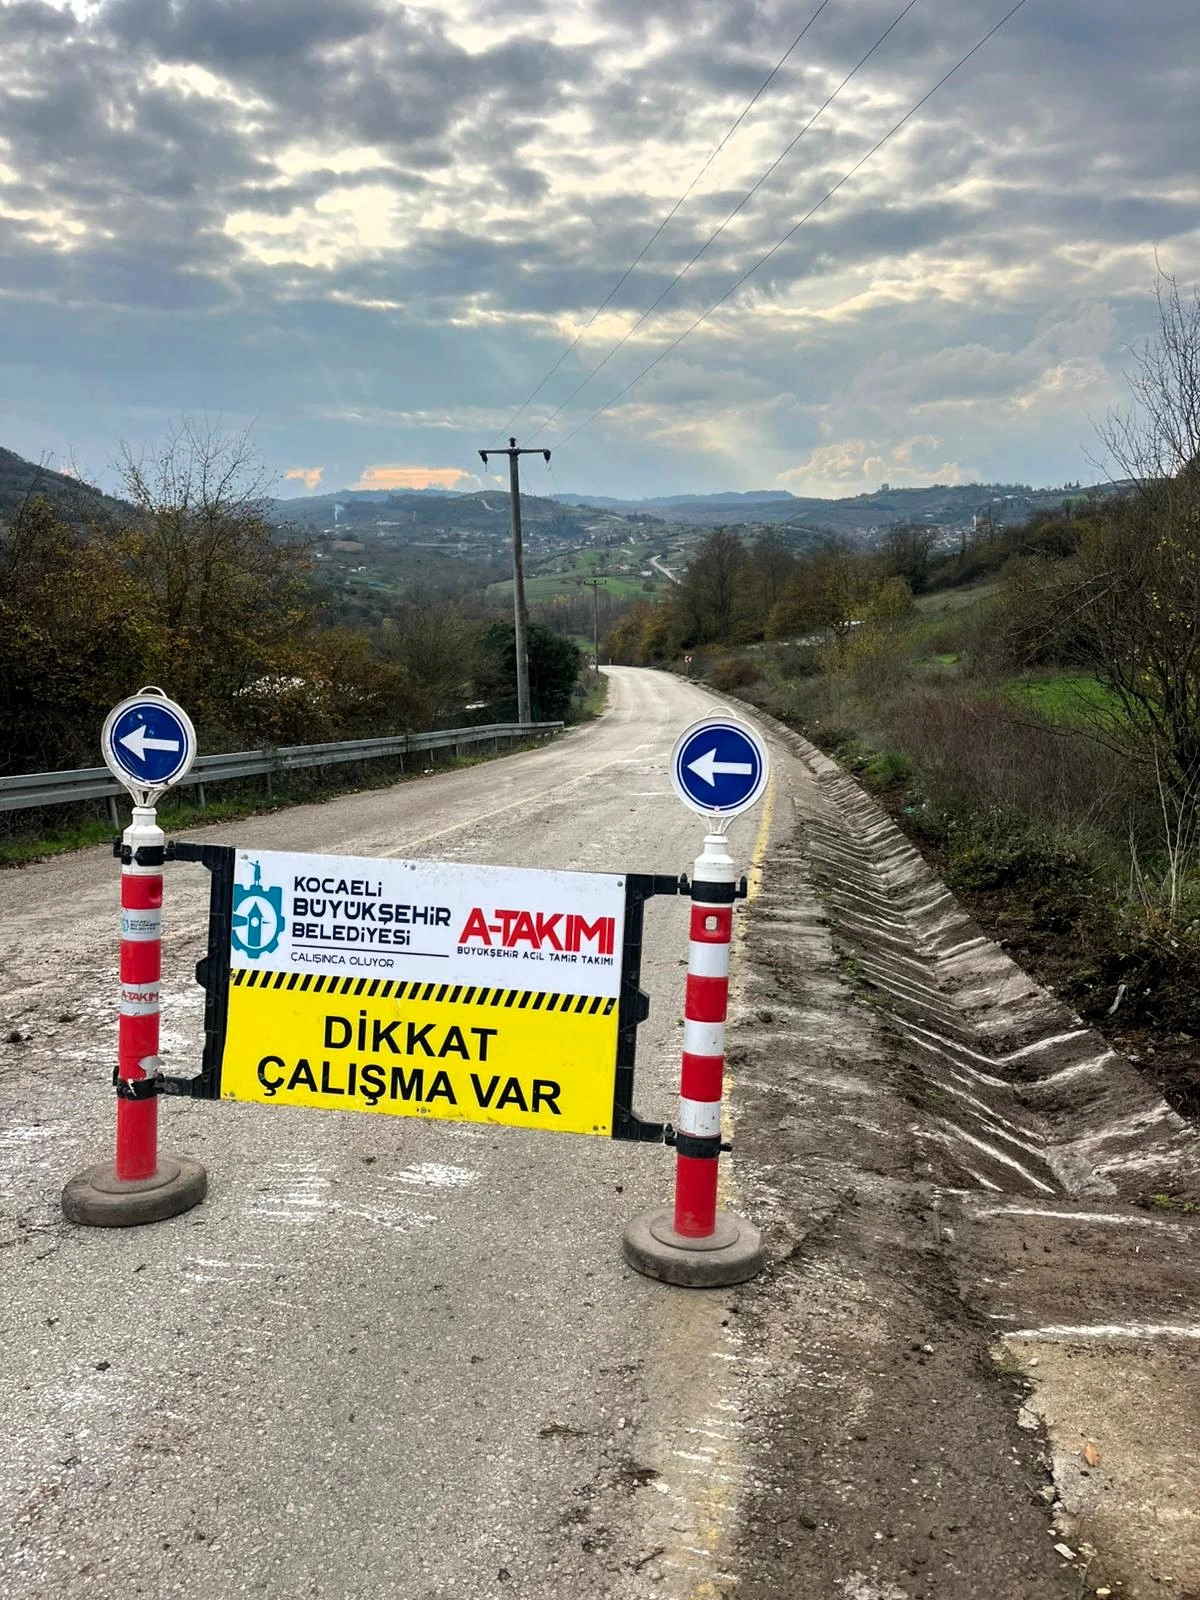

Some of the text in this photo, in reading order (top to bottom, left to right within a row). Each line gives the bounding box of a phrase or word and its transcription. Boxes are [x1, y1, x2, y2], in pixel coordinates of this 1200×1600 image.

[458, 907, 616, 955] A-TAKIMI
[290, 952, 395, 968] ÇALIŞINCA OLUYOR
[581, 955, 614, 966] TAKIMI
[324, 1009, 498, 1062] DİKKAT
[257, 1055, 562, 1115] ÇALIŞMA VAR
